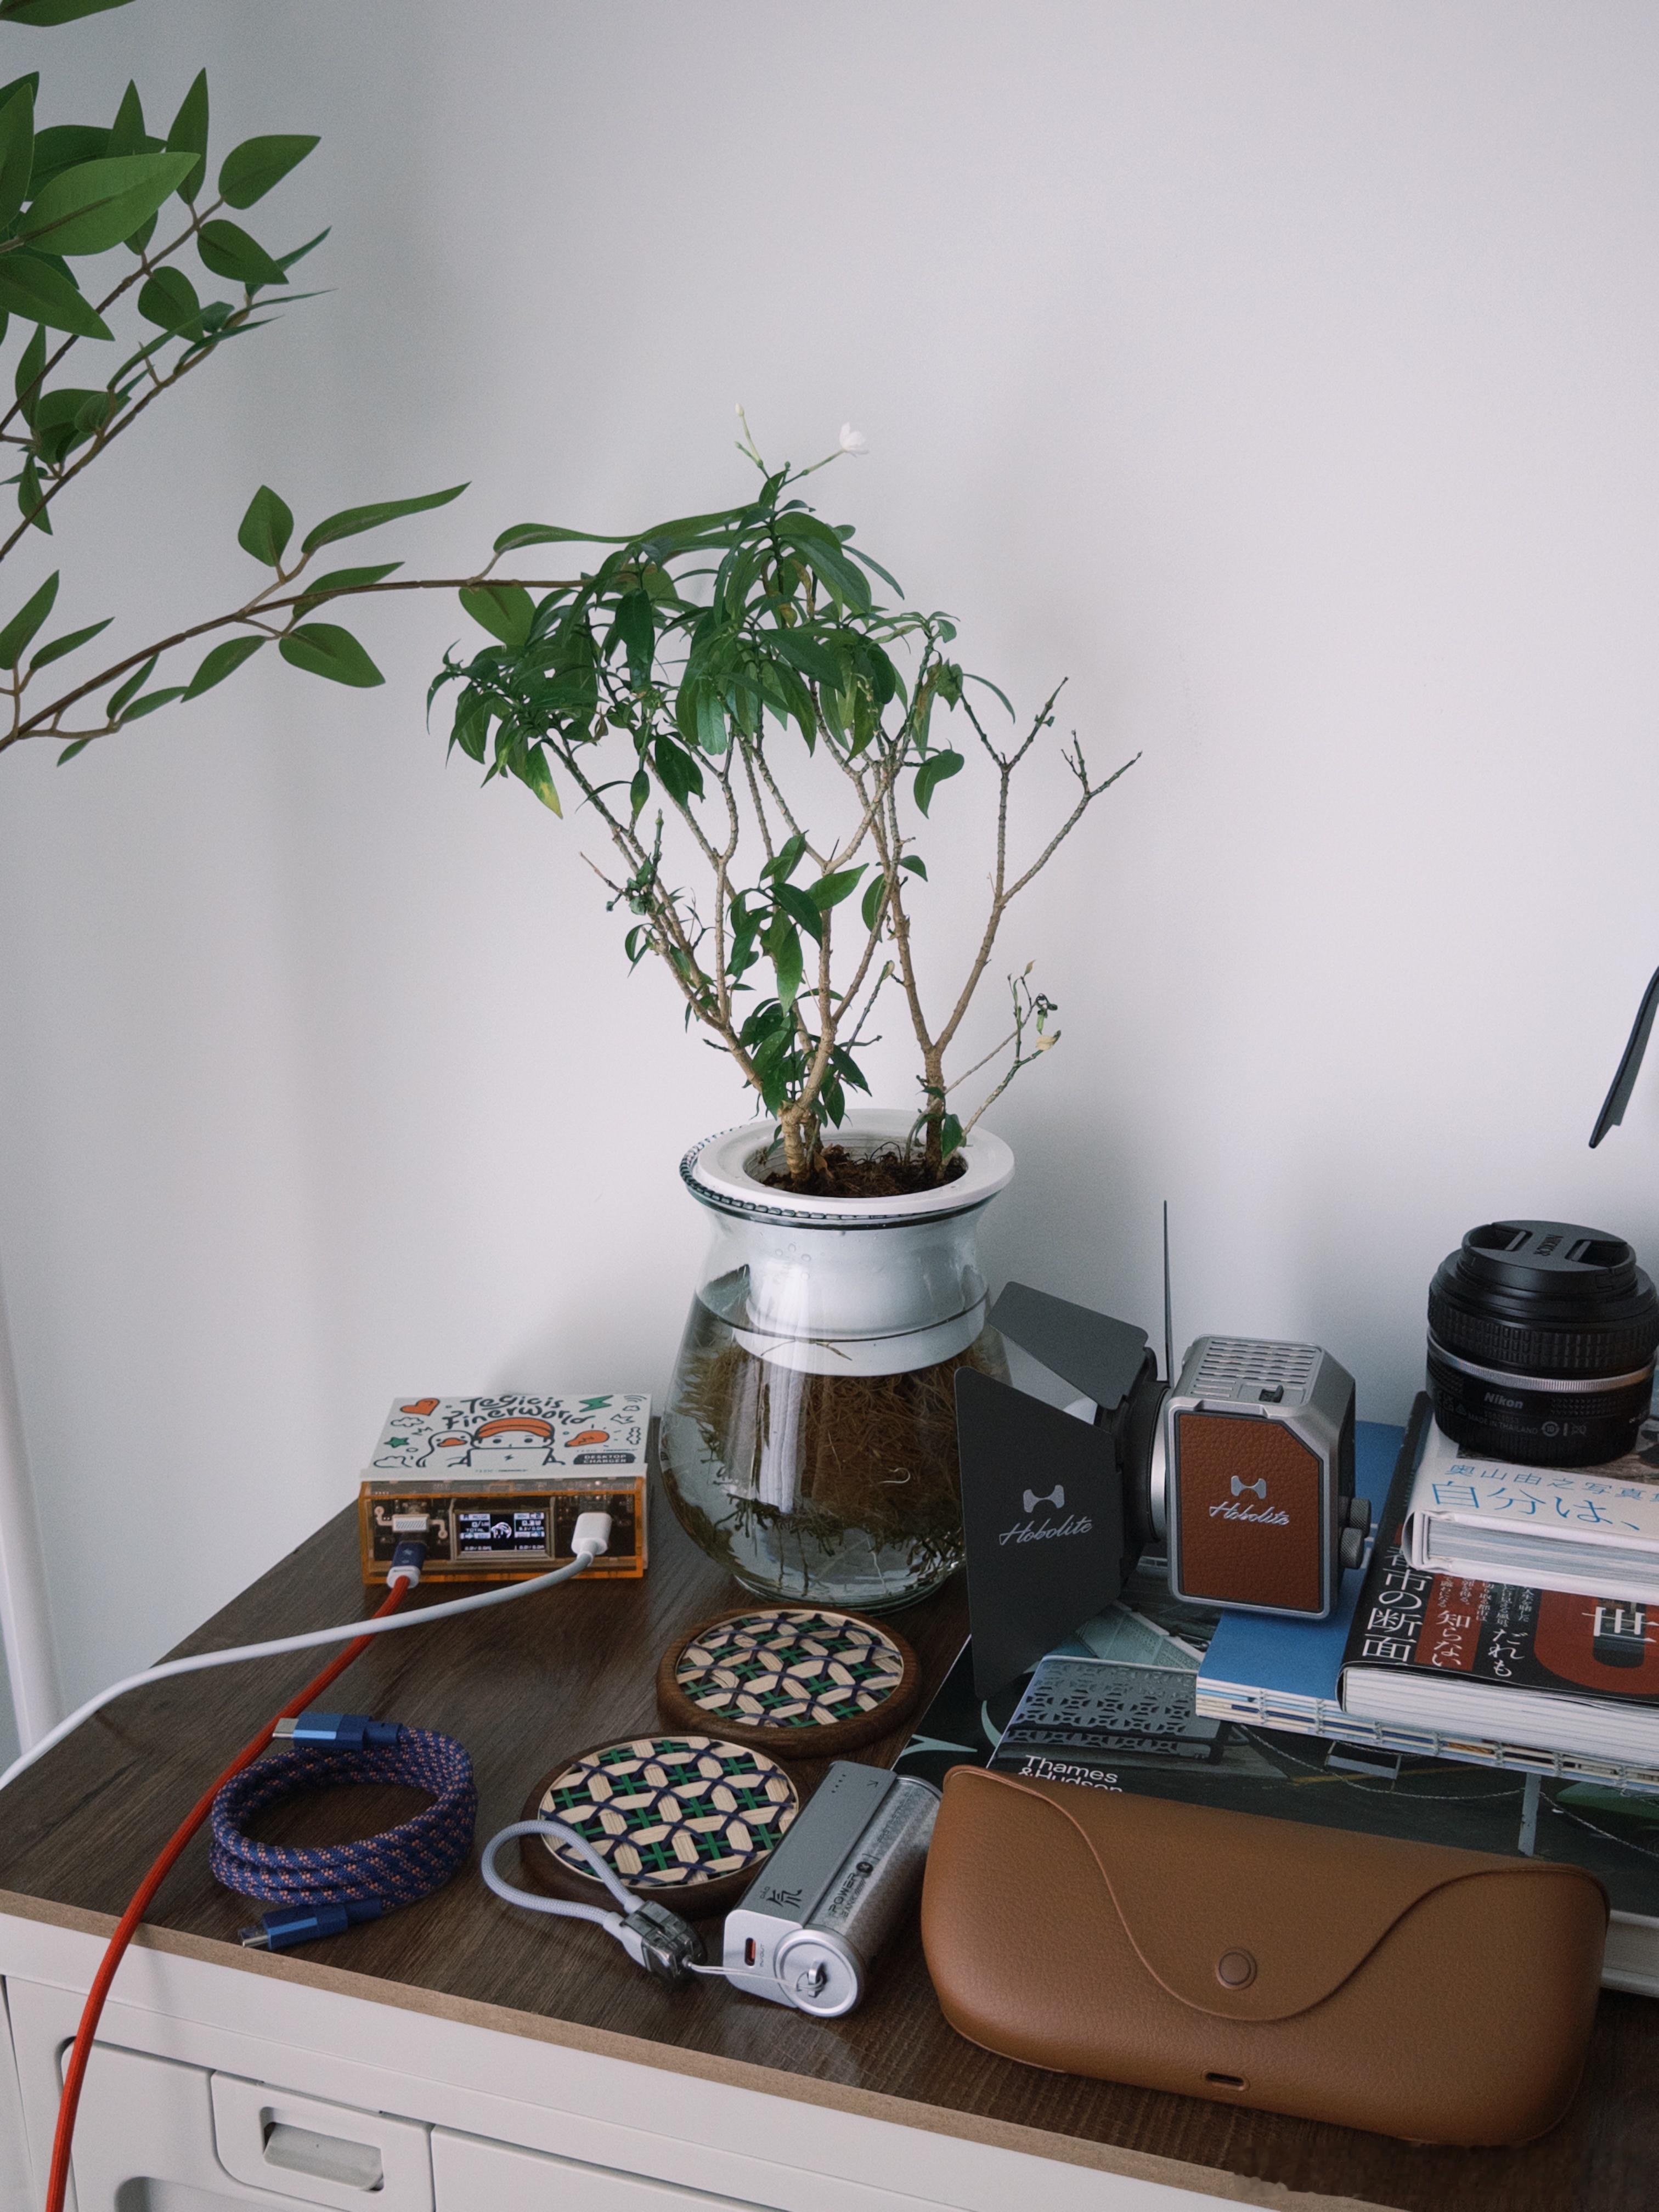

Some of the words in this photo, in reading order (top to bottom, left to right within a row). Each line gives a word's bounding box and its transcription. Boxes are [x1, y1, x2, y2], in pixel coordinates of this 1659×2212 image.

[1484, 1392, 1523, 1409] Nikon
[1468, 1413, 1488, 1425] MADE
[1499, 1421, 1538, 1435] THAILAND
[1209, 1501, 1290, 1526] Hobolite
[999, 1514, 1094, 1546] Hobolite
[1431, 1610, 1471, 1667] 知らない
[1487, 1628, 1528, 1677] だれも
[1025, 1754, 1119, 1784] Thames
[828, 1872, 859, 1914] POWER
